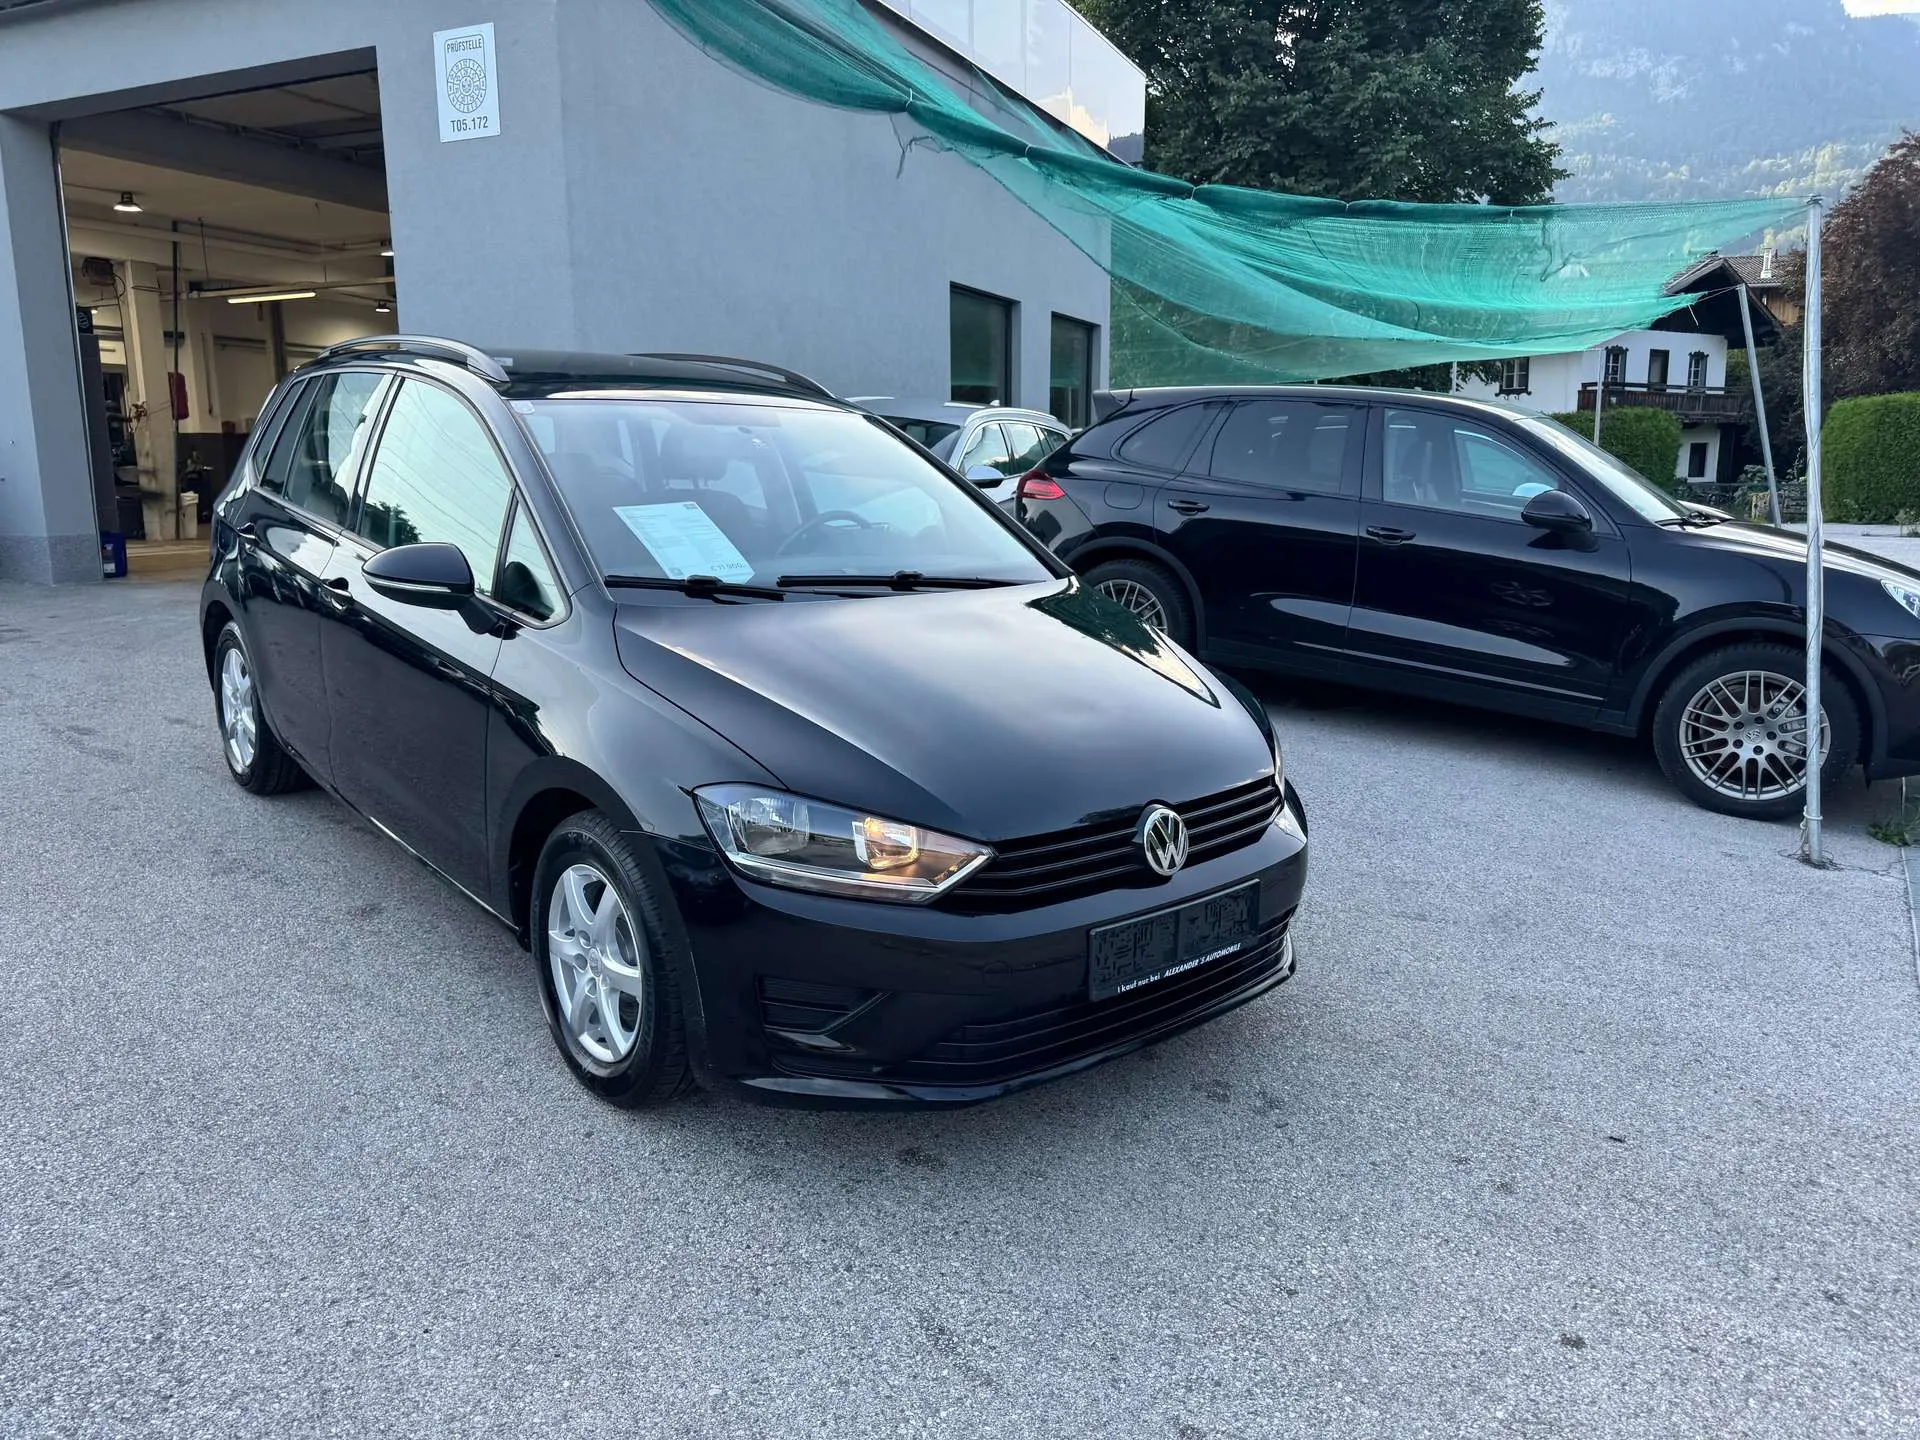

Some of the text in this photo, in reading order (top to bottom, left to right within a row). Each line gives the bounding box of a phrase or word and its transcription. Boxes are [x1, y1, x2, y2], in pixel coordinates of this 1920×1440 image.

[446, 38, 482, 54] PRÜFSTELLE
[450, 116, 488, 132] T05.172
[1145, 809, 1188, 875] VW
[1121, 980, 1136, 992] kauf
[1138, 978, 1149, 987] nur
[1150, 972, 1160, 982] bei
[1205, 942, 1241, 962] AUTOMOBILE
